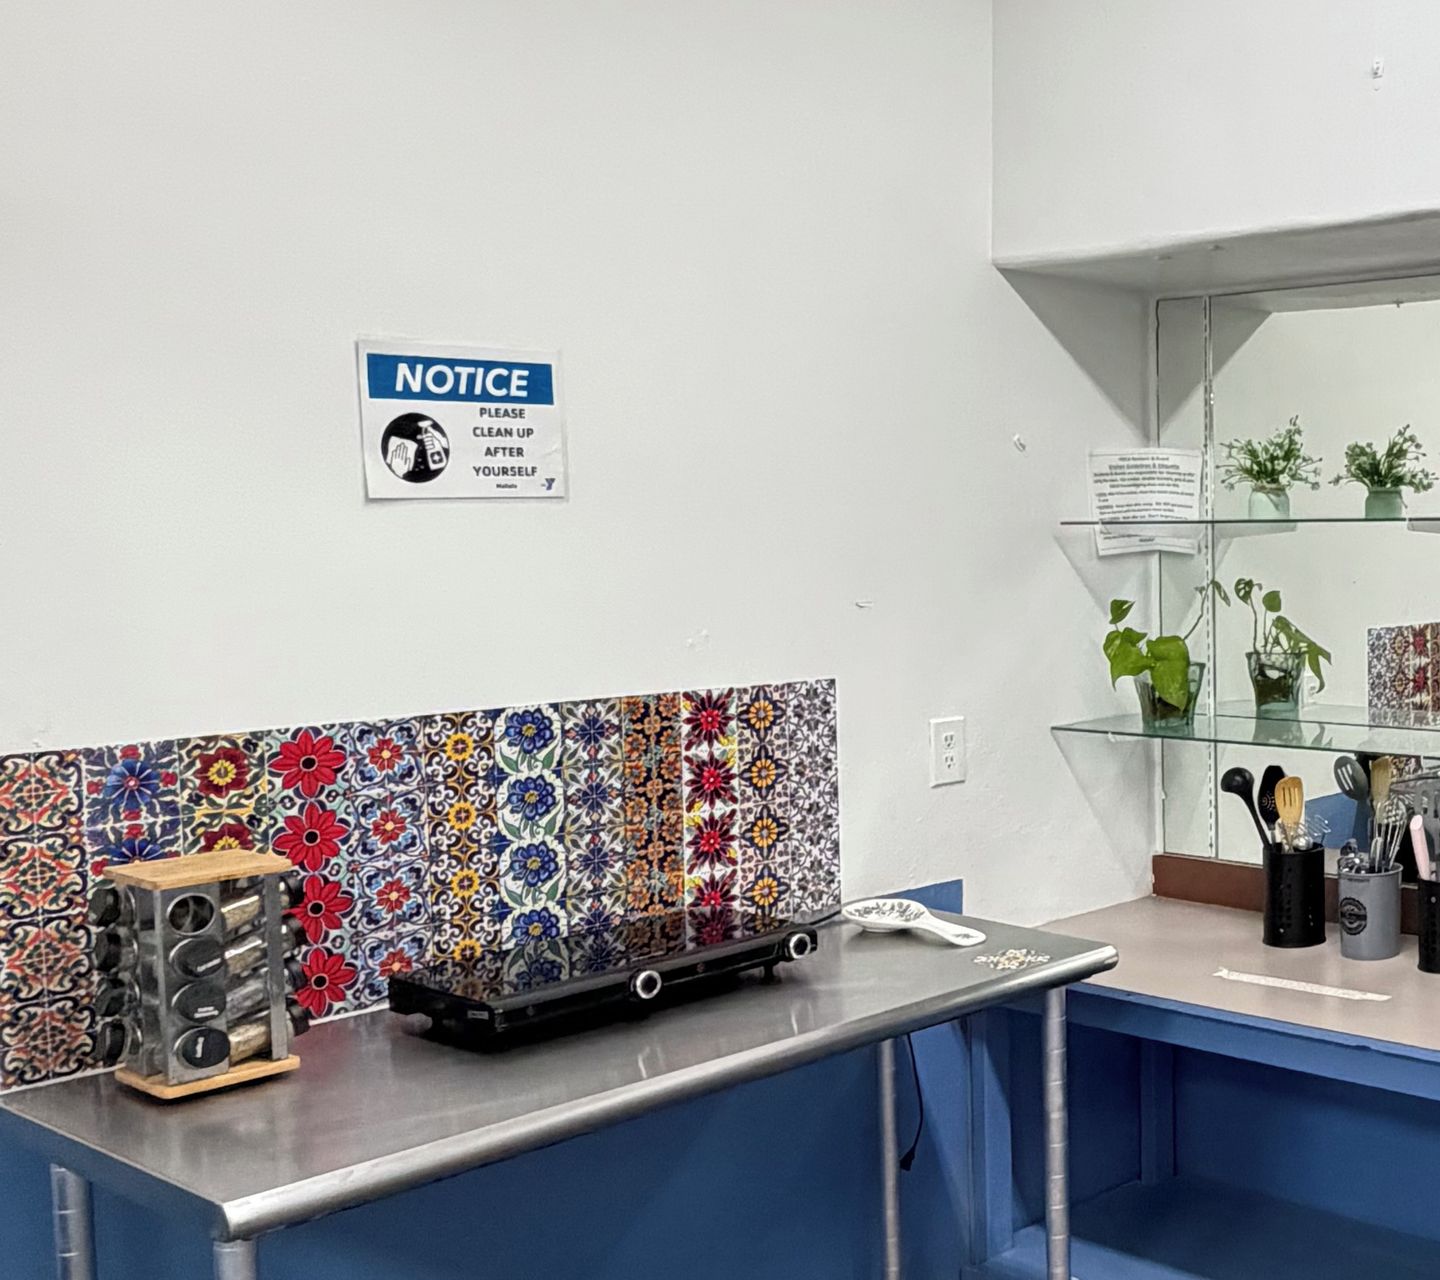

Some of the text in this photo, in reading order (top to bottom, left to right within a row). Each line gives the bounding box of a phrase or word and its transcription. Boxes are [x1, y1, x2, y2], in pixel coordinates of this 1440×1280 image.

[395, 362, 529, 397] NOTICE
[479, 407, 526, 420] PLEASE
[472, 426, 534, 440] CLEAN UP
[484, 446, 525, 458] AFTER
[473, 466, 538, 477] YOURSELF
